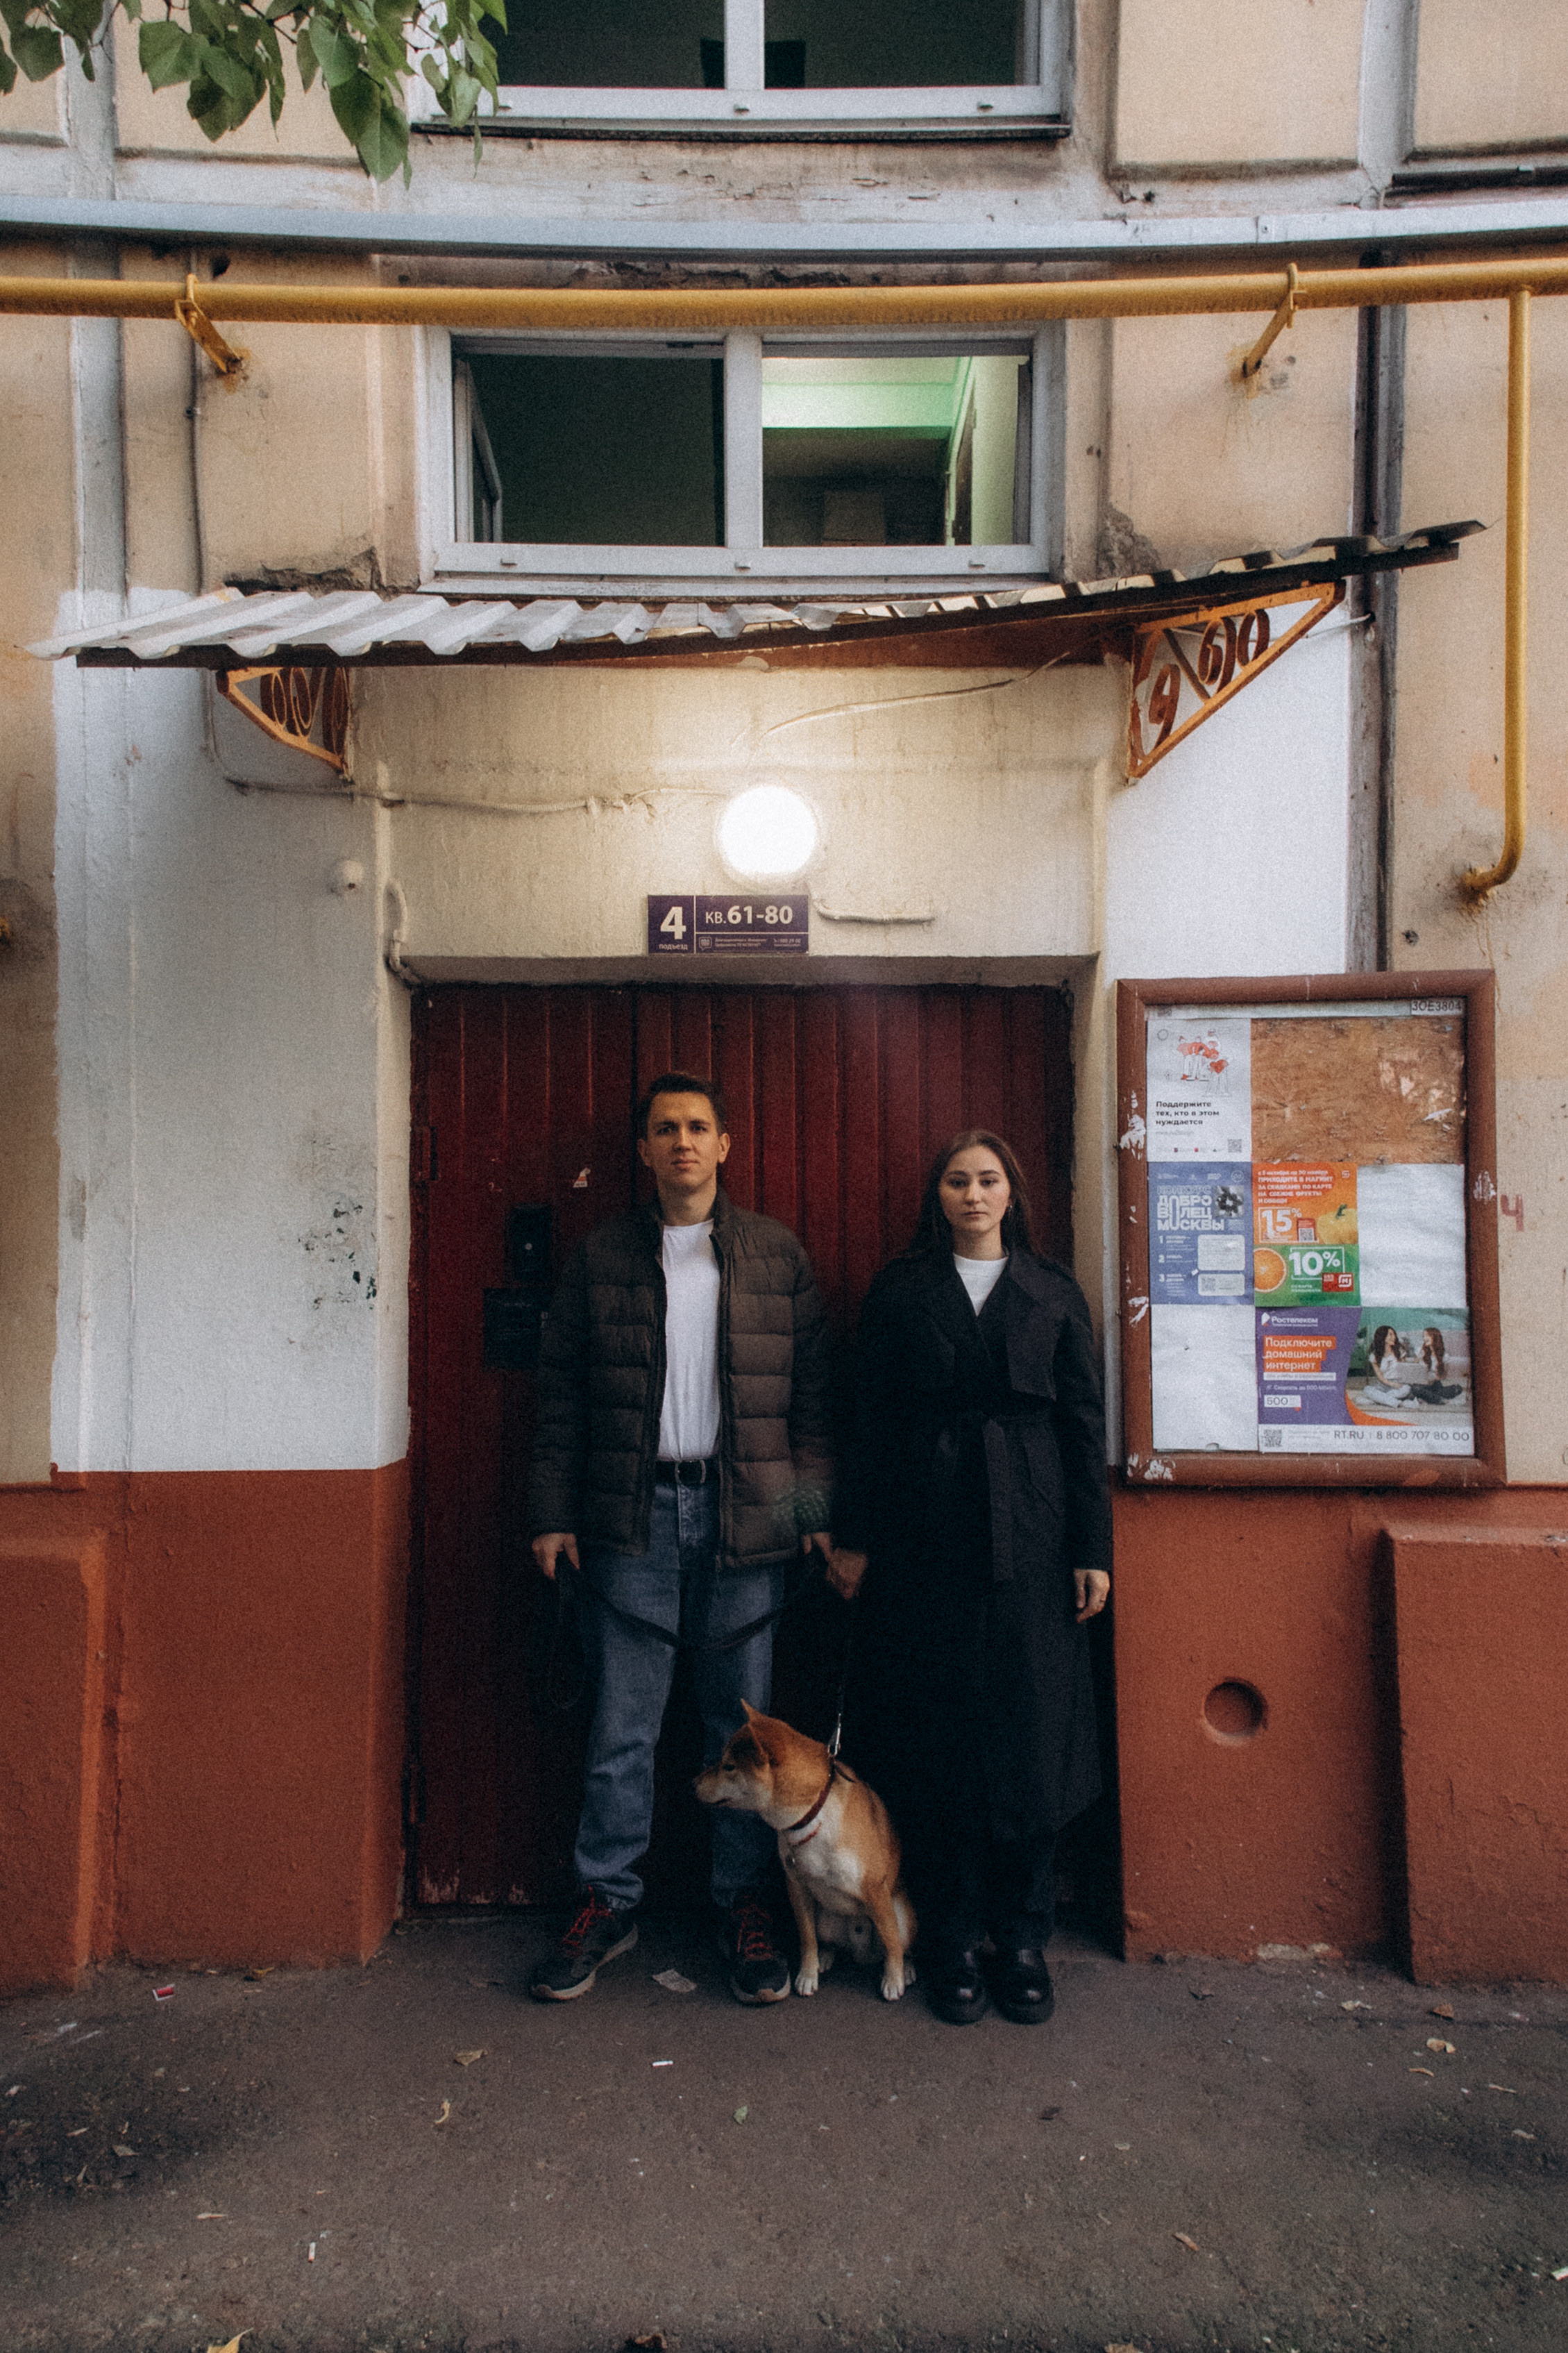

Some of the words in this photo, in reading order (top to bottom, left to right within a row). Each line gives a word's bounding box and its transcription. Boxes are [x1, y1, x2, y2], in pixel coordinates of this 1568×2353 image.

[660, 906, 686, 939] 4
[1289, 1251, 1340, 1275] 10%
[1272, 1316, 1318, 1324] Ростелеком
[1265, 1337, 1332, 1348] Подключите
[1265, 1350, 1322, 1359] домашний
[1266, 1363, 1315, 1371] интернет
[1267, 1397, 1288, 1405] 500
[1376, 1431, 1383, 1439] 8
[1412, 1431, 1430, 1439] 707
[1434, 1432, 1449, 1440] 80
[1453, 1432, 1469, 1441] 00
